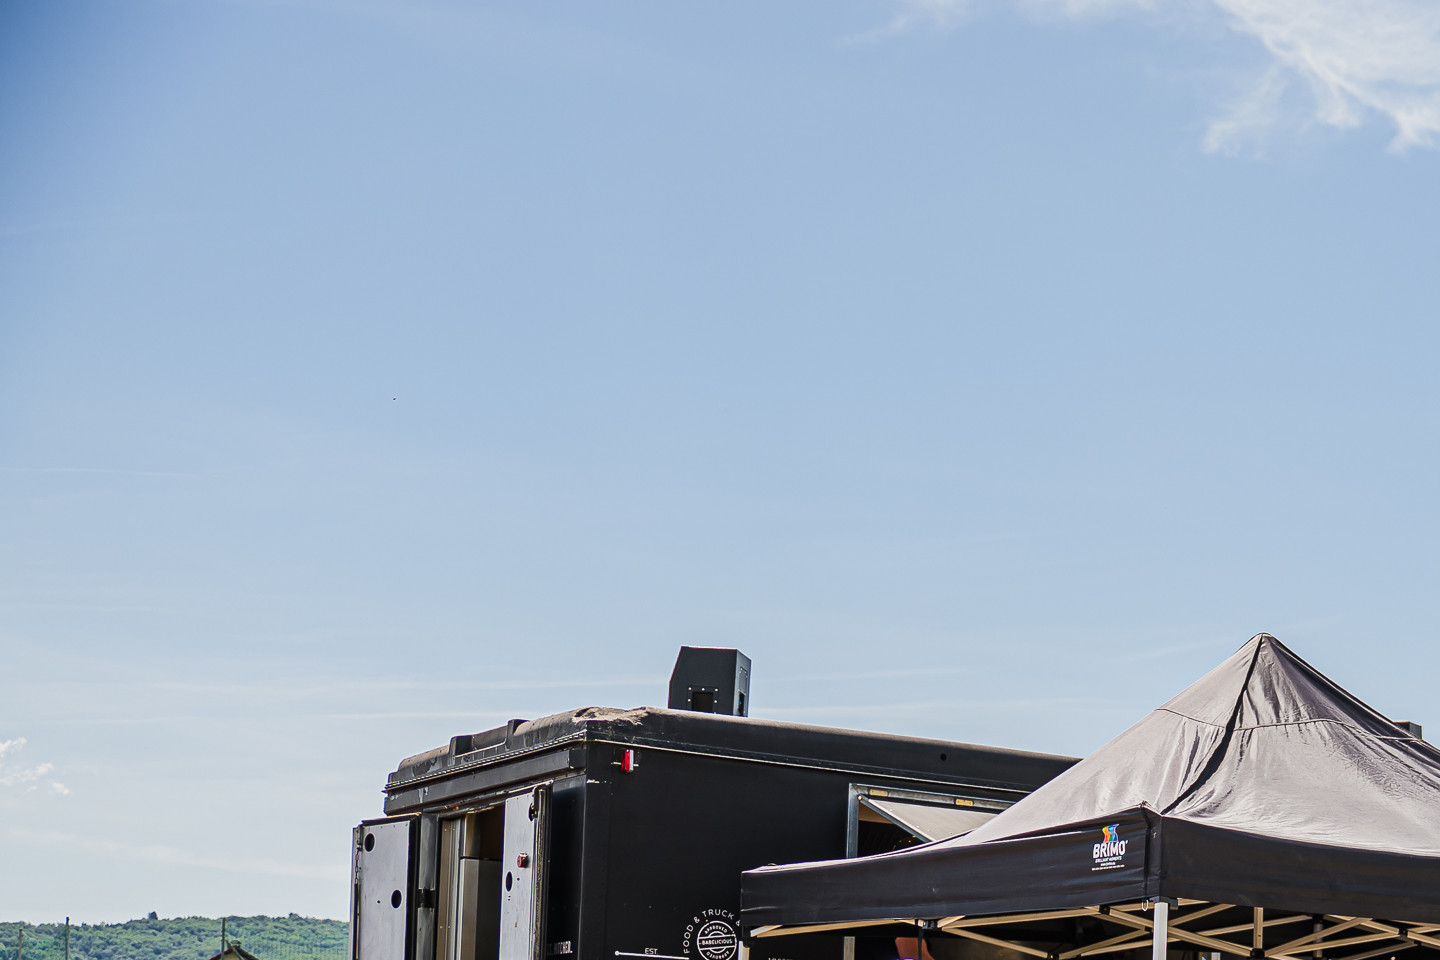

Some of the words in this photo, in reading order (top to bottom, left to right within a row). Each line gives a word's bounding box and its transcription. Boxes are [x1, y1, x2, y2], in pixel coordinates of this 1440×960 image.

[1093, 840, 1126, 859] BRIMO
[683, 925, 694, 954] FOOD
[694, 916, 700, 924] &
[702, 909, 734, 920] TRUCK
